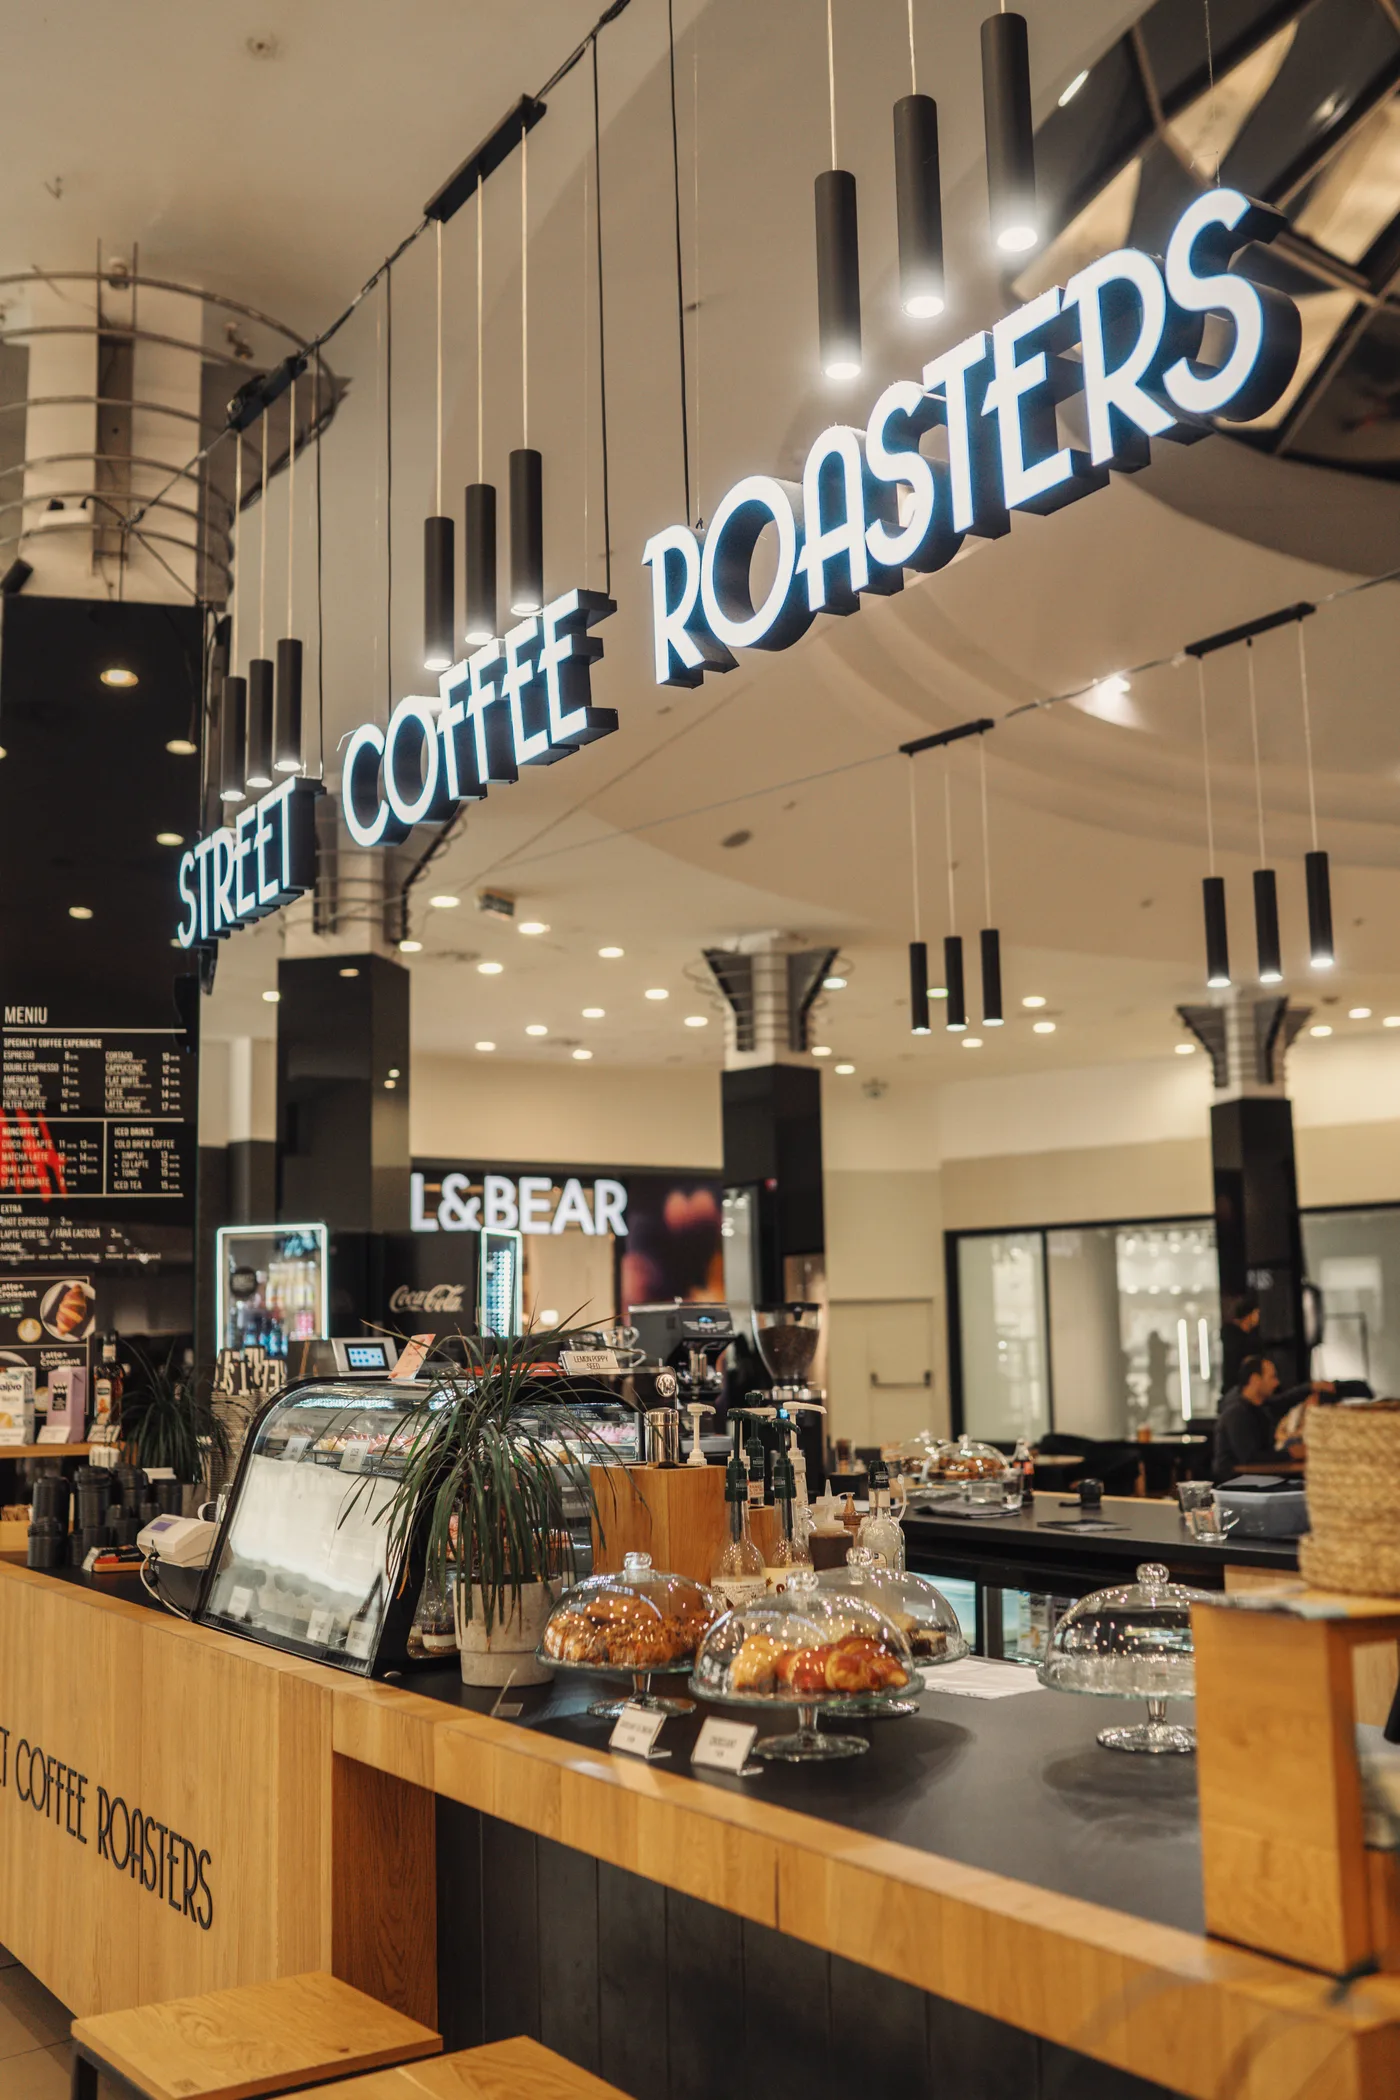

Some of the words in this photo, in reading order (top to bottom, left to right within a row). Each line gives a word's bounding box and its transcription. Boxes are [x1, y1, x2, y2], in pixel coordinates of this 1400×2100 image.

[177, 775, 298, 950] STREET
[341, 588, 592, 848] COFFEE
[641, 187, 1267, 687] ROASTERS
[4, 1006, 48, 1024] MENIU
[3, 1037, 37, 1048] SPECIALTY
[38, 1038, 62, 1049] COFFEE
[63, 1038, 102, 1049] EXPERIENCE
[3, 1050, 35, 1060] ESPRESSO
[3, 1063, 27, 1073] DOUBLE
[28, 1063, 59, 1073] ESPRESSO
[3, 1075, 39, 1084] AMERICANO
[20, 1088, 40, 1097] BLACK
[105, 1088, 124, 1097] LATTE
[3, 1100, 22, 1110] FILTER
[23, 1100, 46, 1110] COFFEE
[104, 1100, 123, 1109] LATTE
[1, 1127, 40, 1137] NONCOFFEE
[114, 1127, 129, 1137] ICED
[130, 1127, 154, 1137] DRINKS
[32, 1140, 52, 1149] LAPTE
[114, 1139, 131, 1149] COLD
[132, 1139, 150, 1149] BREW
[151, 1139, 175, 1150] COFFEE
[2, 1152, 28, 1161] MATCHA
[29, 1152, 48, 1162] LATTE
[17, 1165, 37, 1175] LATTE
[114, 1180, 129, 1190] ICED
[130, 1181, 142, 1190] TEA
[0, 1204, 22, 1214] EXTRA
[18, 1217, 49, 1226] ESPRESSO
[0, 1229, 20, 1239] LAPTE
[21, 1229, 46, 1239] VEGETAL
[573, 1355, 591, 1363] LEMON
[16, 1738, 89, 1845] COFFEE
[97, 1785, 213, 1931] ROASTERS
